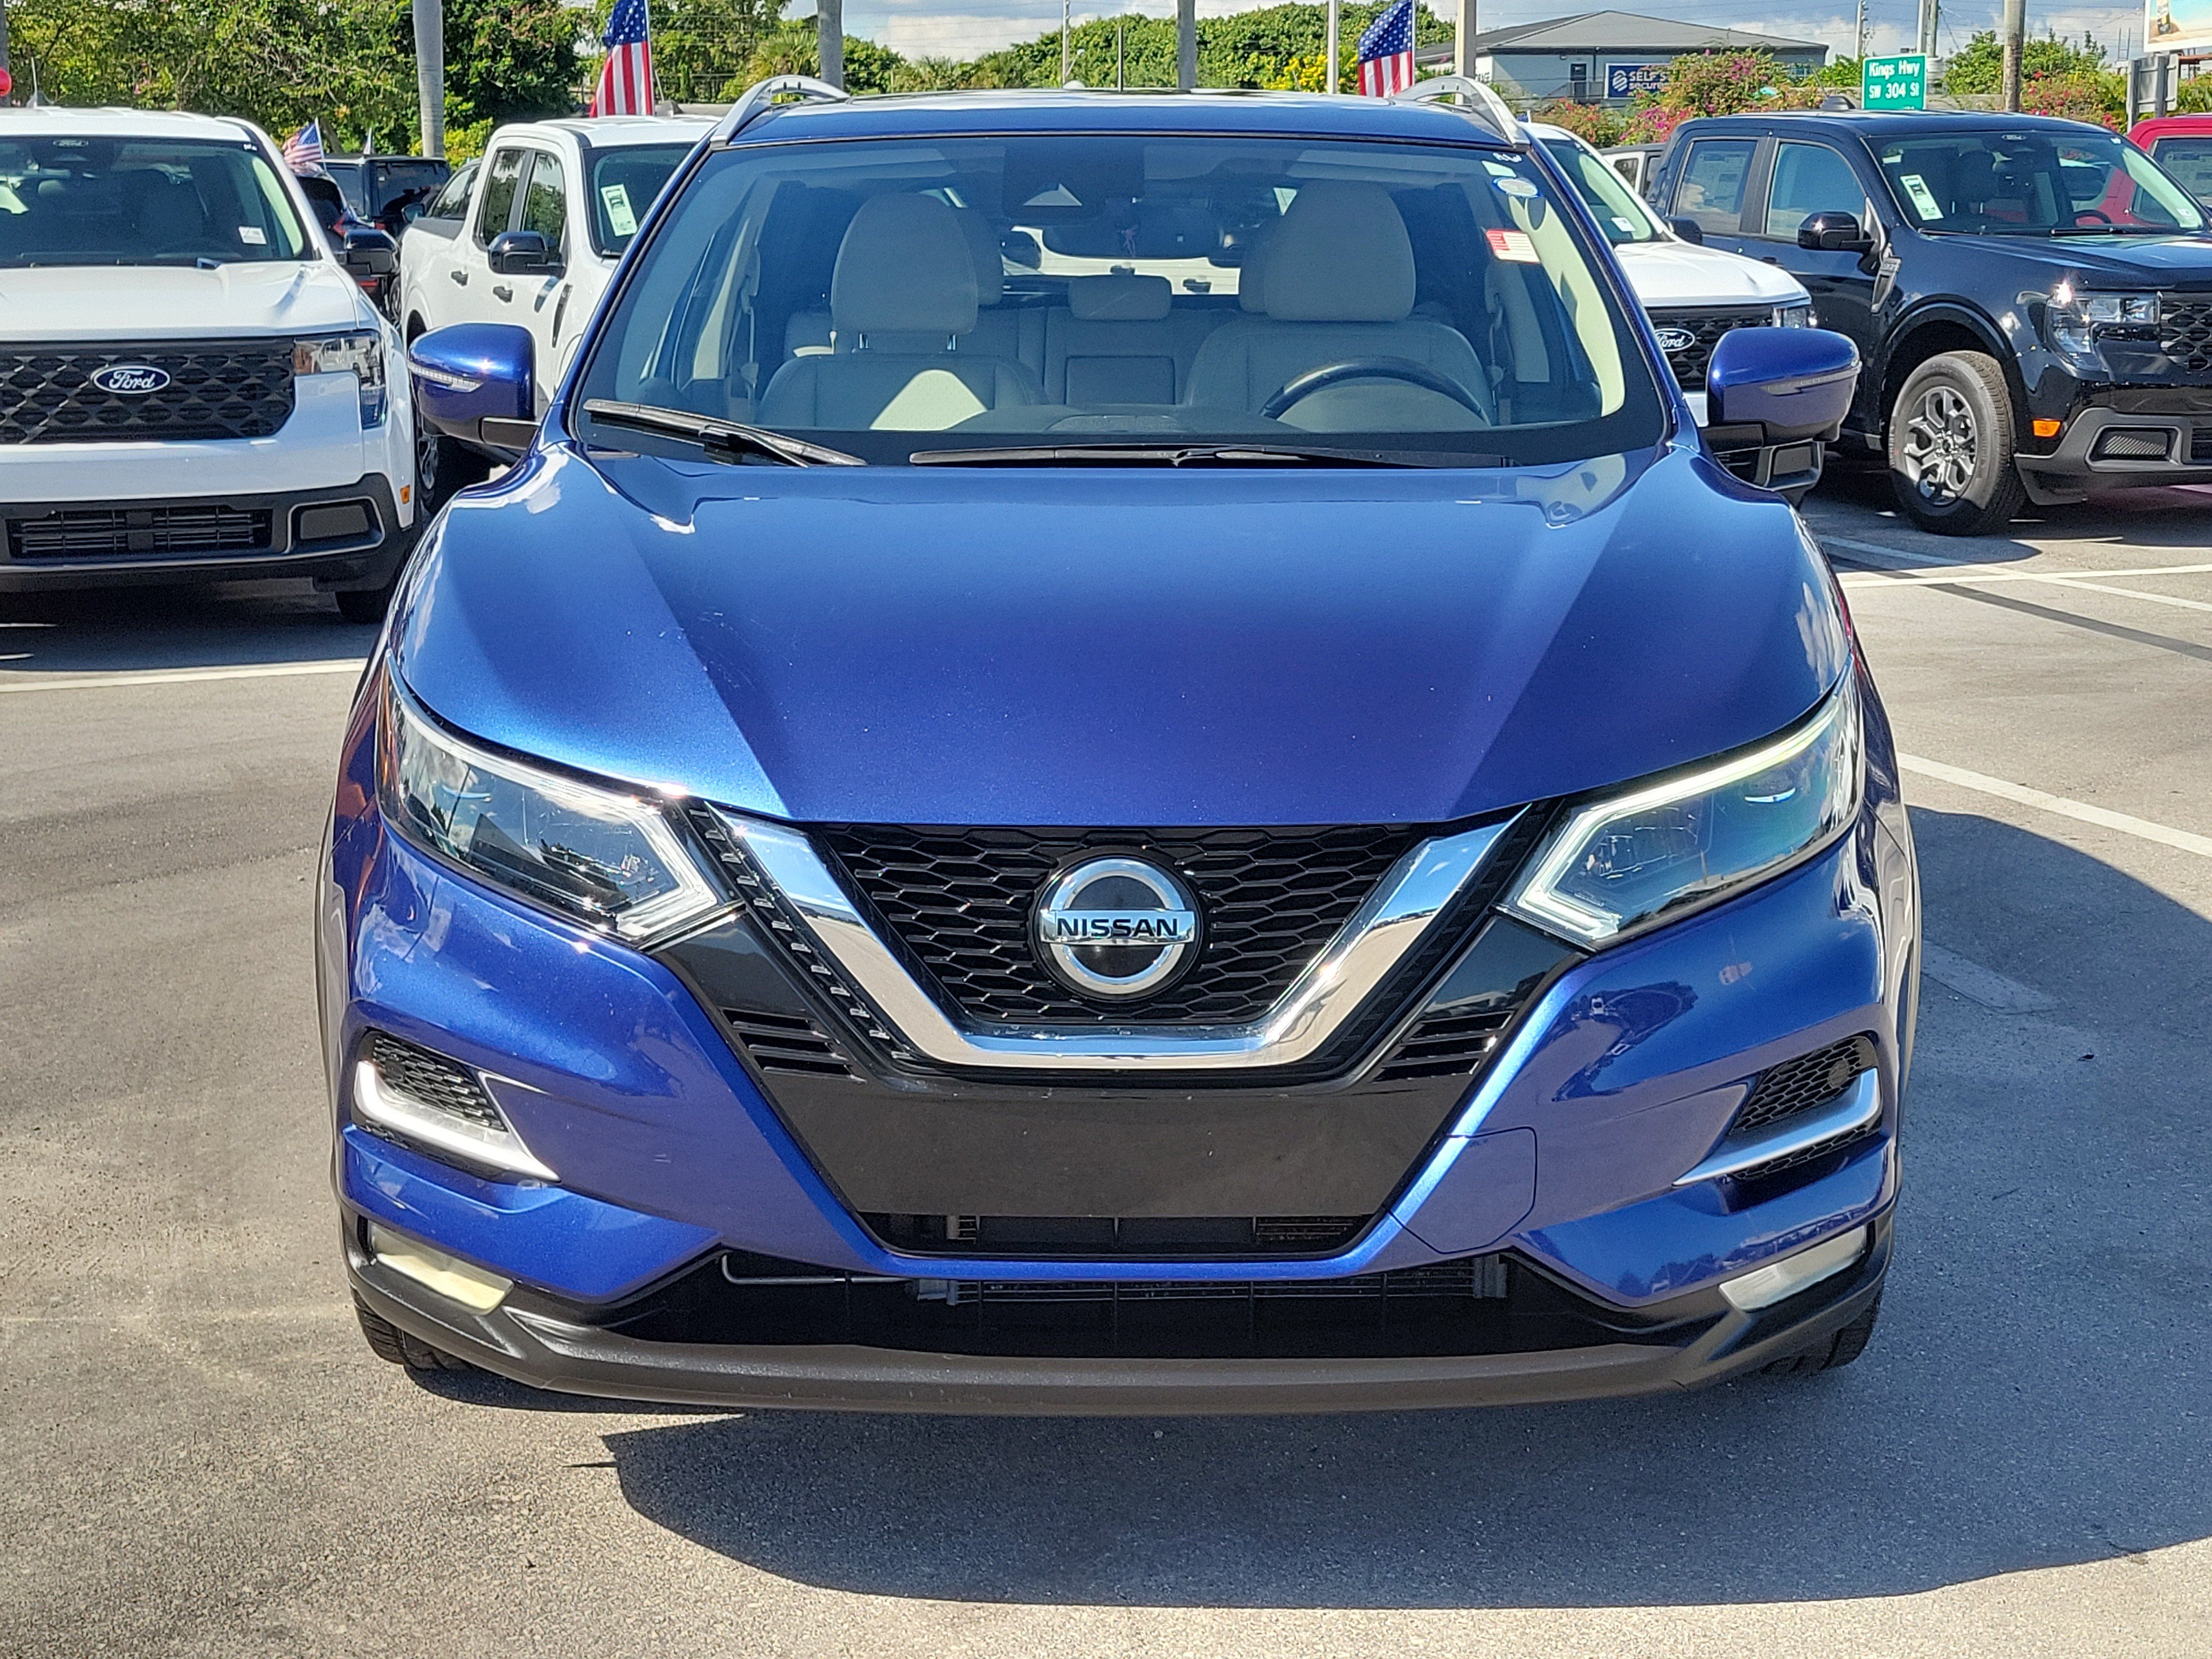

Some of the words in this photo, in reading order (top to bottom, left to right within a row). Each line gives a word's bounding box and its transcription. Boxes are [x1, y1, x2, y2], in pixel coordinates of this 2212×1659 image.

[1869, 62, 1895, 80] Kings
[1899, 60, 1920, 77] Hwy
[1869, 84, 1882, 99] SW
[1885, 82, 1906, 99] 304
[109, 370, 156, 388] Ford
[1057, 918, 1178, 937] NISSAN
